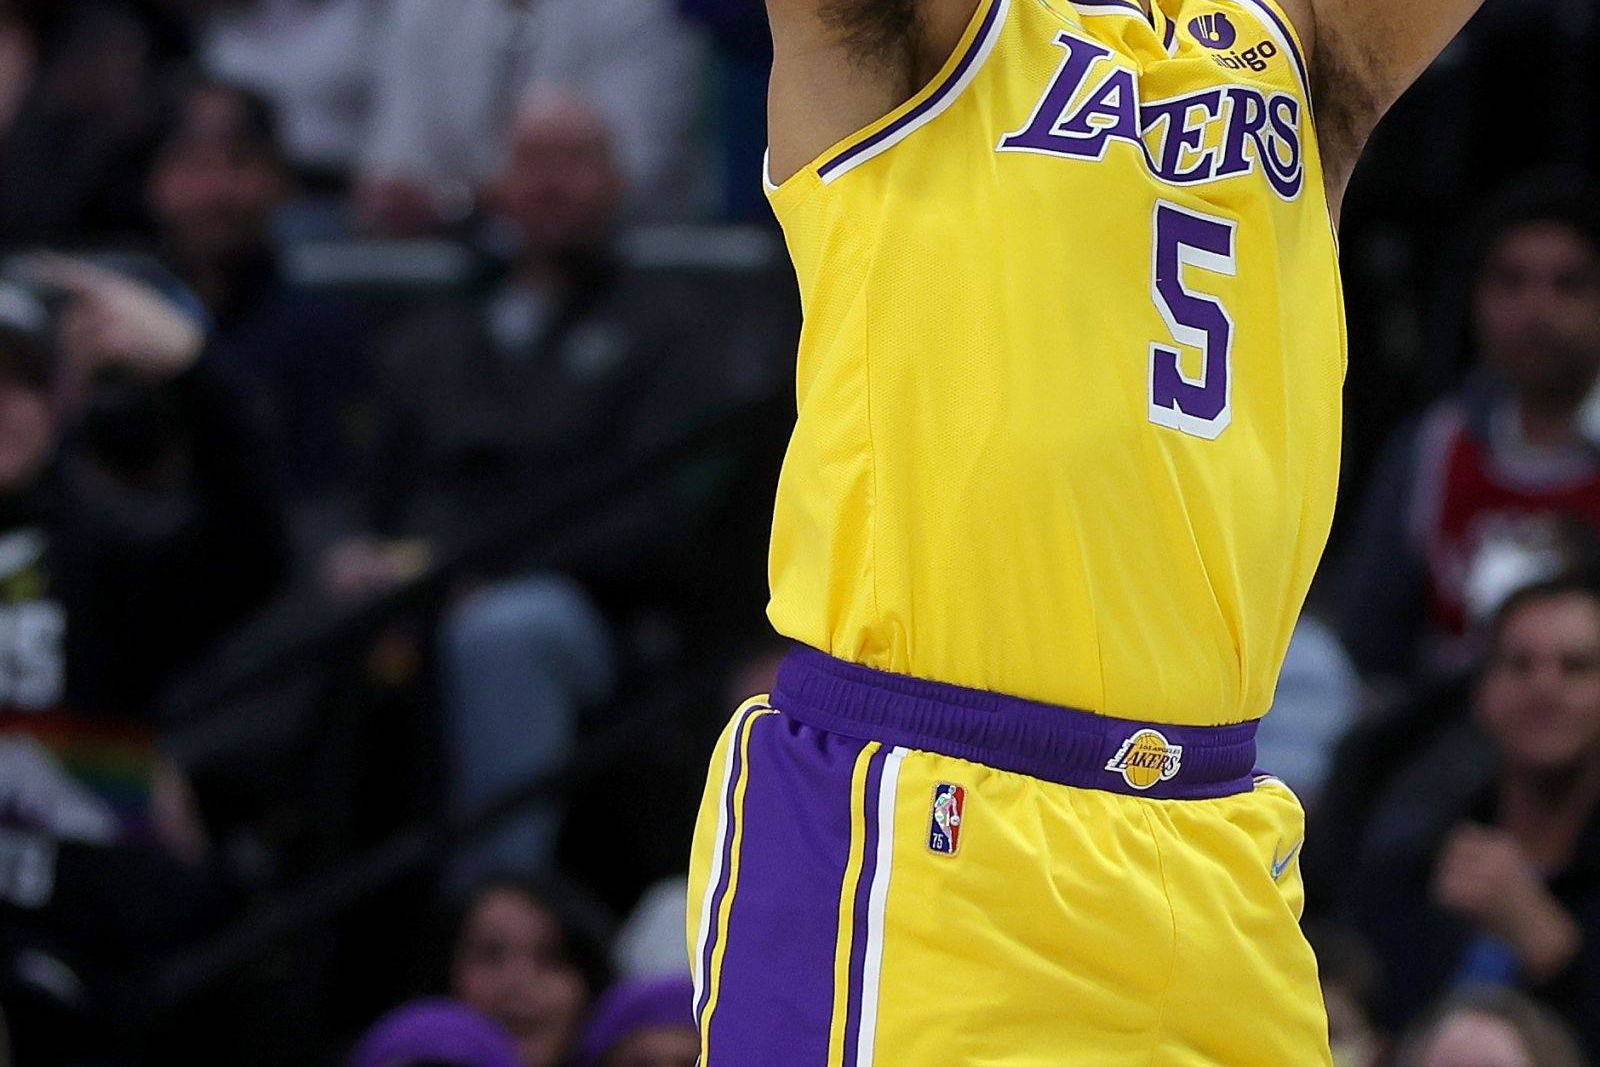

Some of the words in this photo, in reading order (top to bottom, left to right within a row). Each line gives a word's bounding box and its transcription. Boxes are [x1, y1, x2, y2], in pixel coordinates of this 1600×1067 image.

[1148, 198, 1238, 441] 5
[1109, 742, 1179, 777] LAKERS
[932, 833, 944, 849] 75
